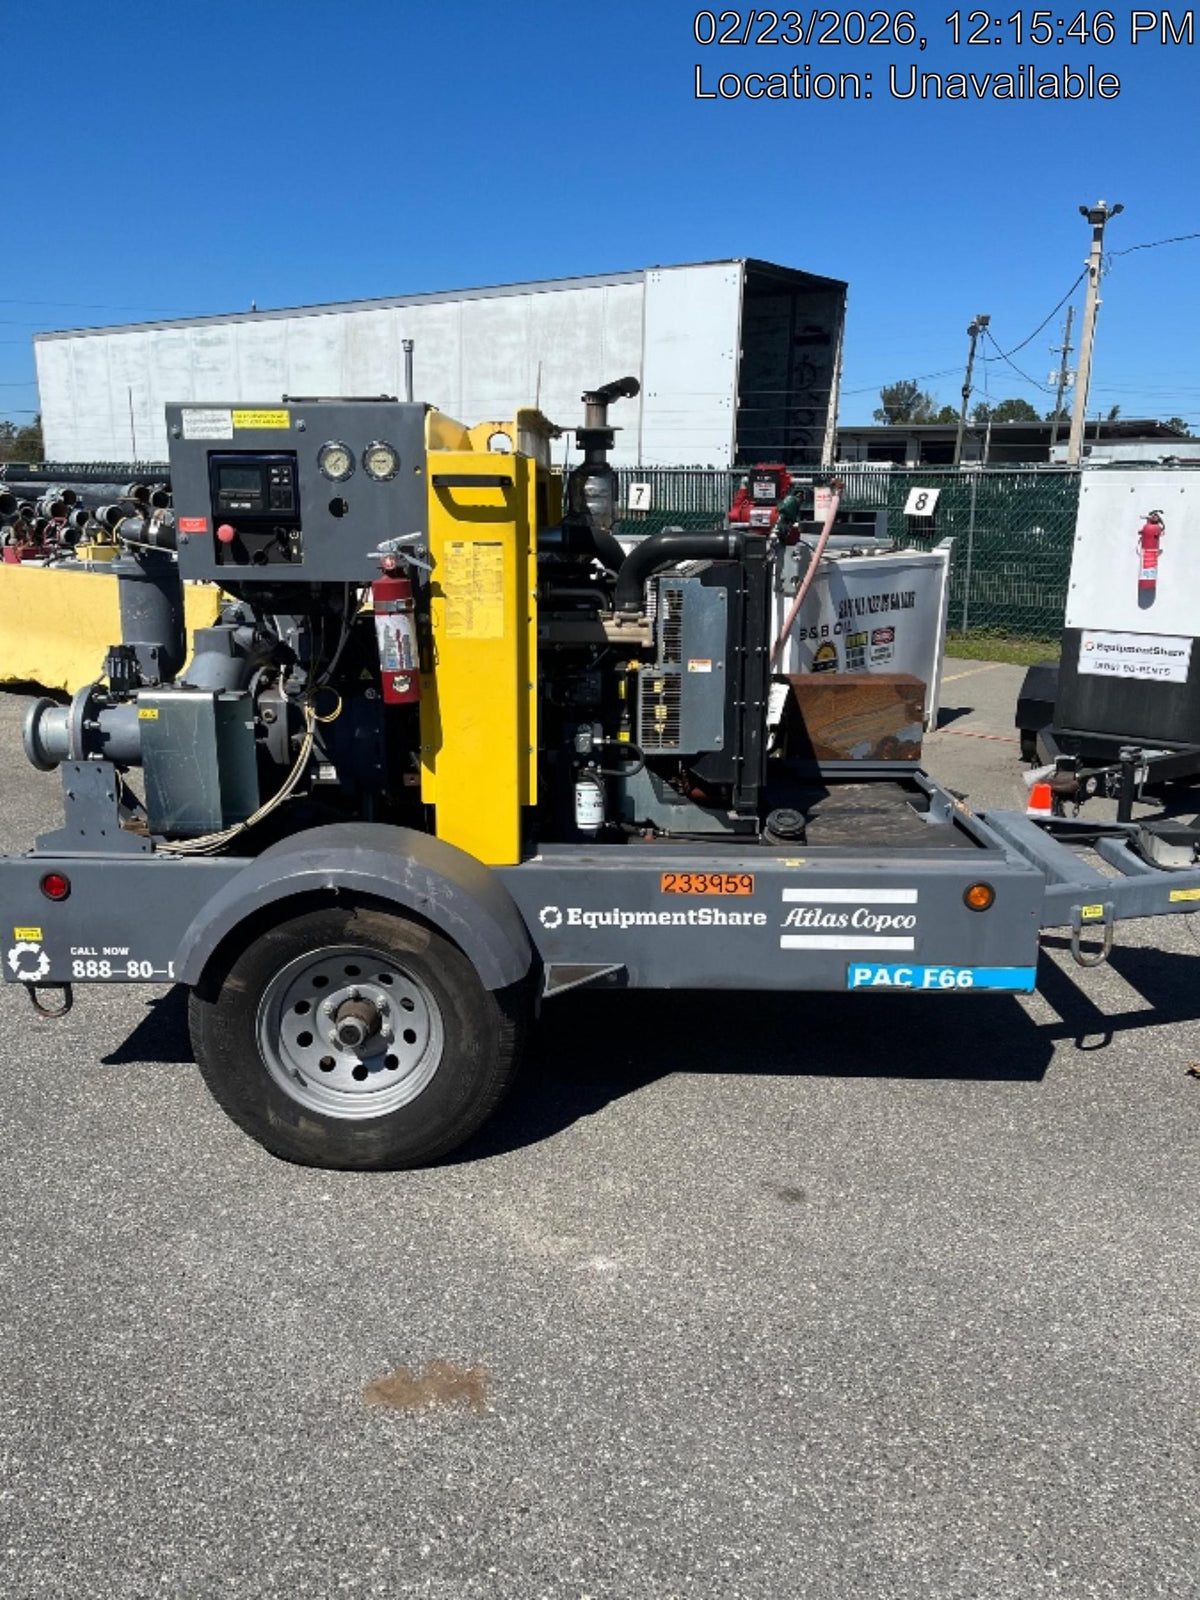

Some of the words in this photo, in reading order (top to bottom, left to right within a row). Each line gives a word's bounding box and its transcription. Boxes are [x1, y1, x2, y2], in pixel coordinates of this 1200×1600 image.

[635, 487, 645, 506] 7
[915, 492, 929, 511] 8
[1096, 642, 1185, 657] EquipmentShare
[662, 873, 754, 894] 233959
[566, 907, 768, 929] EquipmentShare
[780, 907, 849, 929] Atlas
[851, 907, 917, 932] Copco
[70, 947, 98, 956] CALL
[103, 947, 130, 956] NOW
[853, 967, 912, 988] PAC
[922, 969, 974, 988] F66
